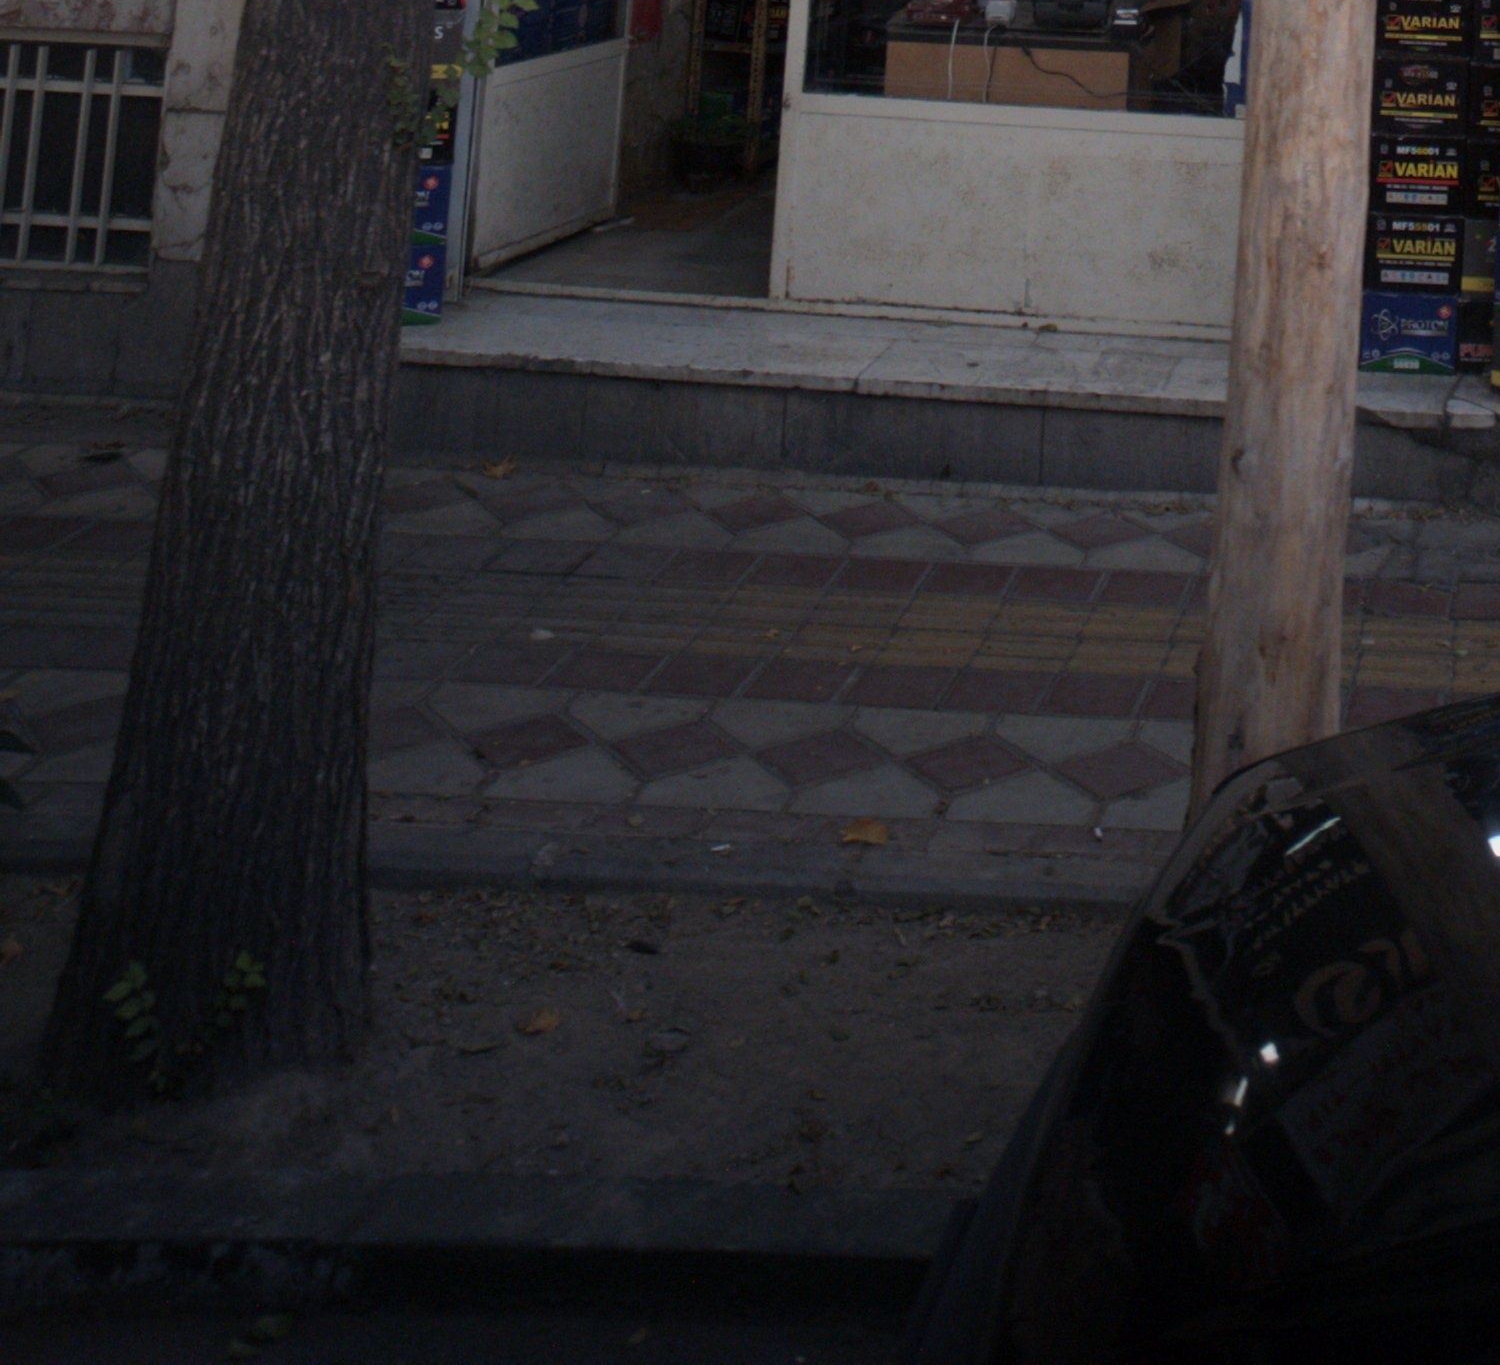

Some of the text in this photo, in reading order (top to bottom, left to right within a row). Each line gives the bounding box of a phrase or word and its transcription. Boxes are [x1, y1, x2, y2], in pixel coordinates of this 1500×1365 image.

[1400, 15, 1460, 30] VARIAN
[1395, 92, 1456, 107] VARIAN
[1394, 161, 1459, 179] VARIAN
[1392, 238, 1456, 256] VARIAN
